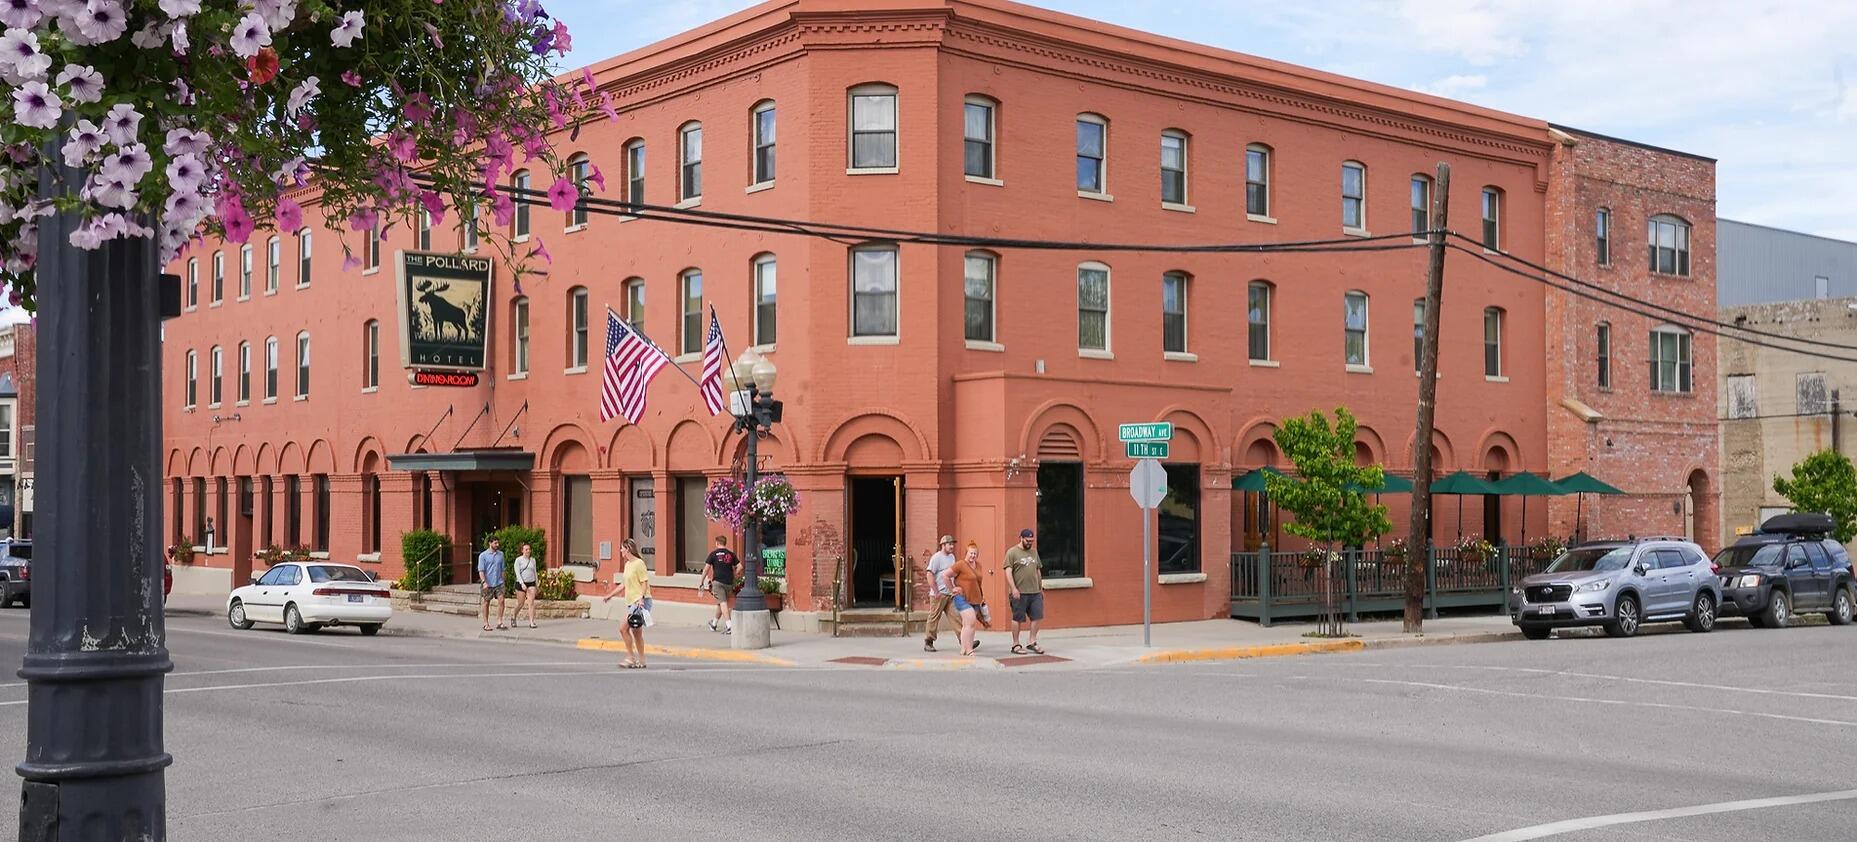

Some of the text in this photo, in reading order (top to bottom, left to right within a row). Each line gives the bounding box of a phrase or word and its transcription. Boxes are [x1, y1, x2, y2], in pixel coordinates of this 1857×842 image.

[406, 255, 488, 271] THE POLLARD
[420, 354, 475, 364] HOTEL
[417, 373, 475, 385] DINING ROOM
[1122, 426, 1167, 438] BROADWAY AVE
[1133, 443, 1149, 455] 11TH
[1151, 447, 1157, 455] ST
